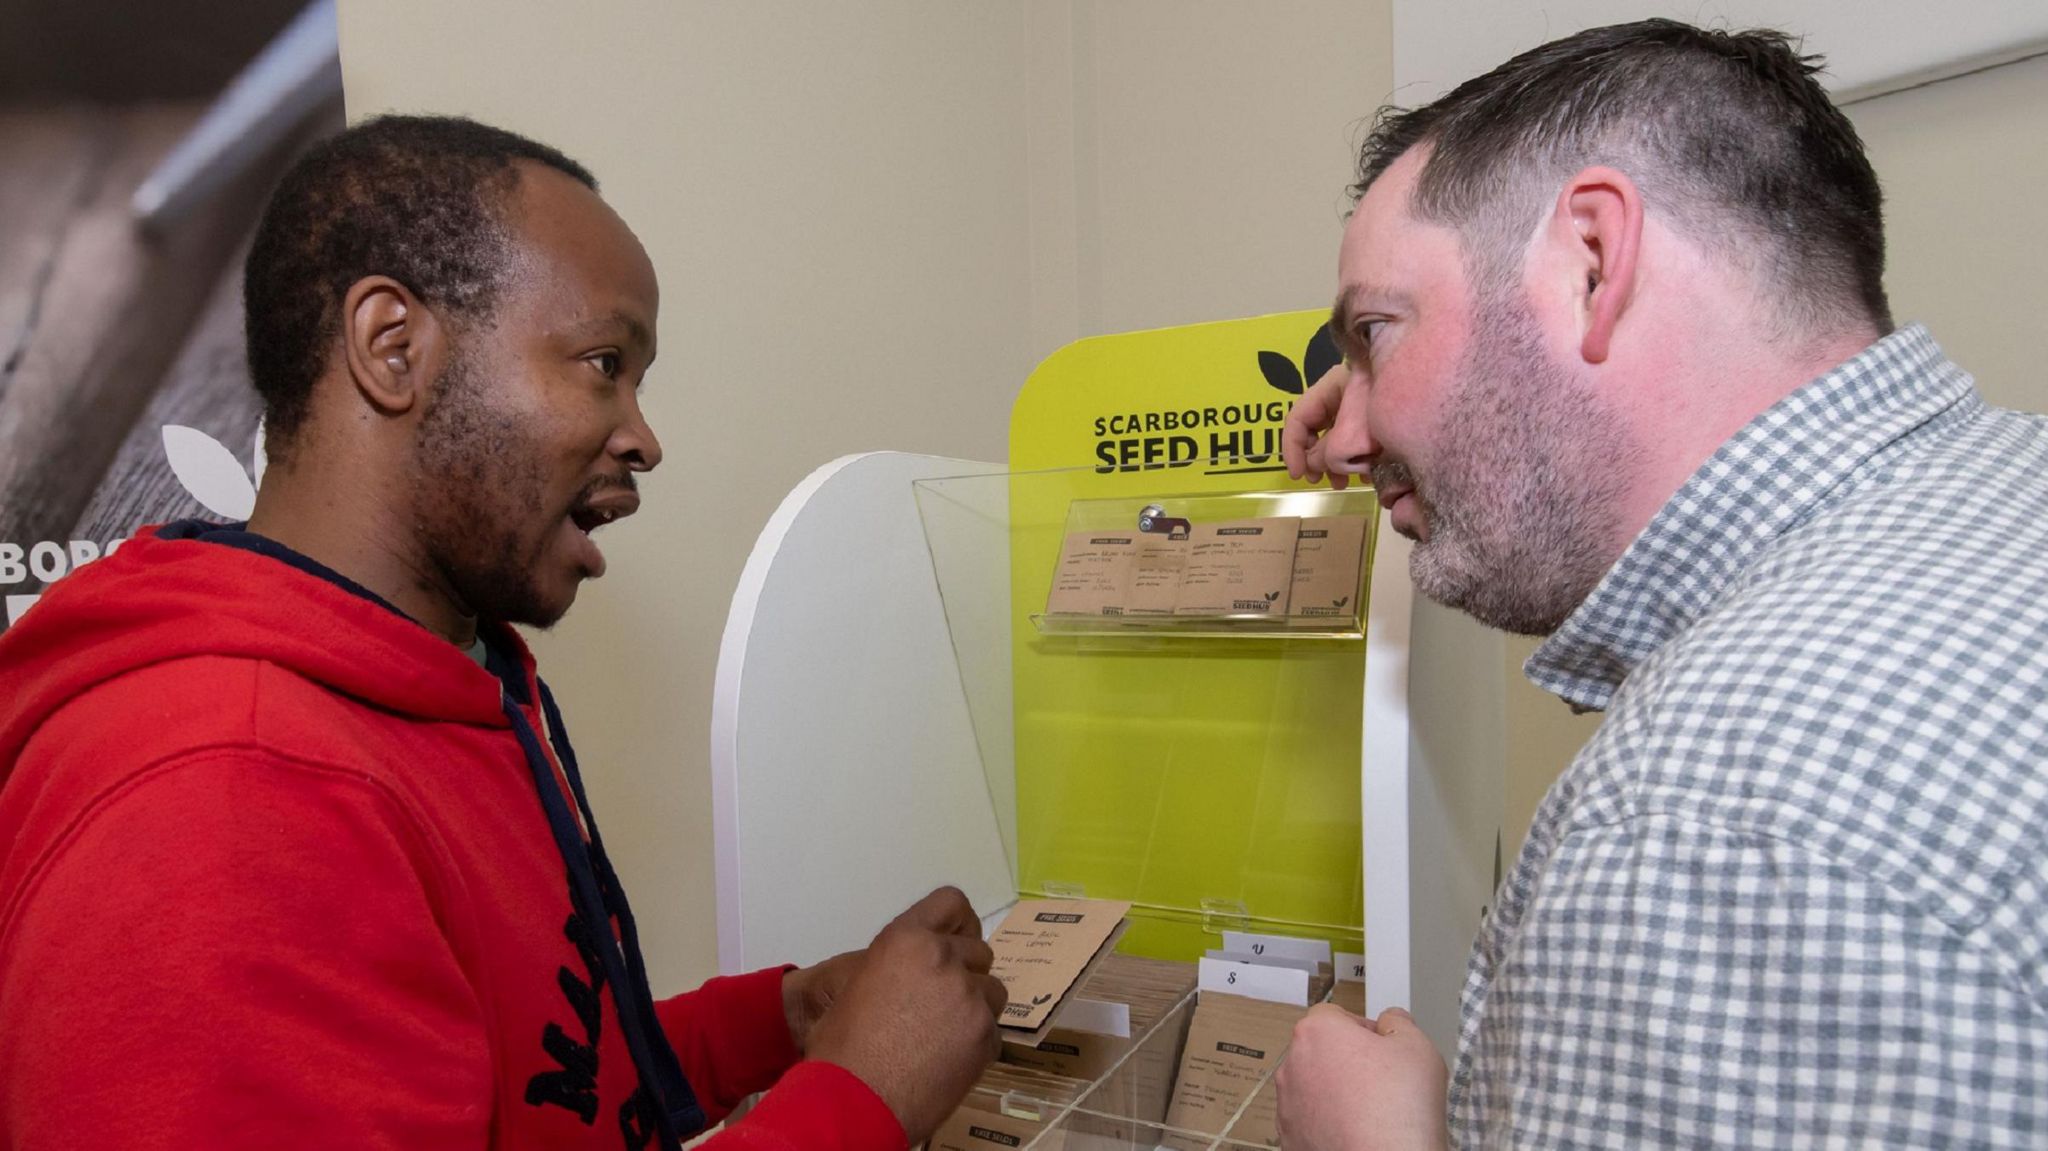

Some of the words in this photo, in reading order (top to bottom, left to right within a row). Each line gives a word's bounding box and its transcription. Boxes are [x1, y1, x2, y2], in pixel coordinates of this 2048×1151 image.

[1094, 401, 1293, 437] SCARBOROUG
[1095, 435, 1199, 474] SEED
[1209, 427, 1284, 466] HU
[0, 538, 128, 585] BOR
[1252, 943, 1264, 955] U
[1227, 971, 1237, 984] S
